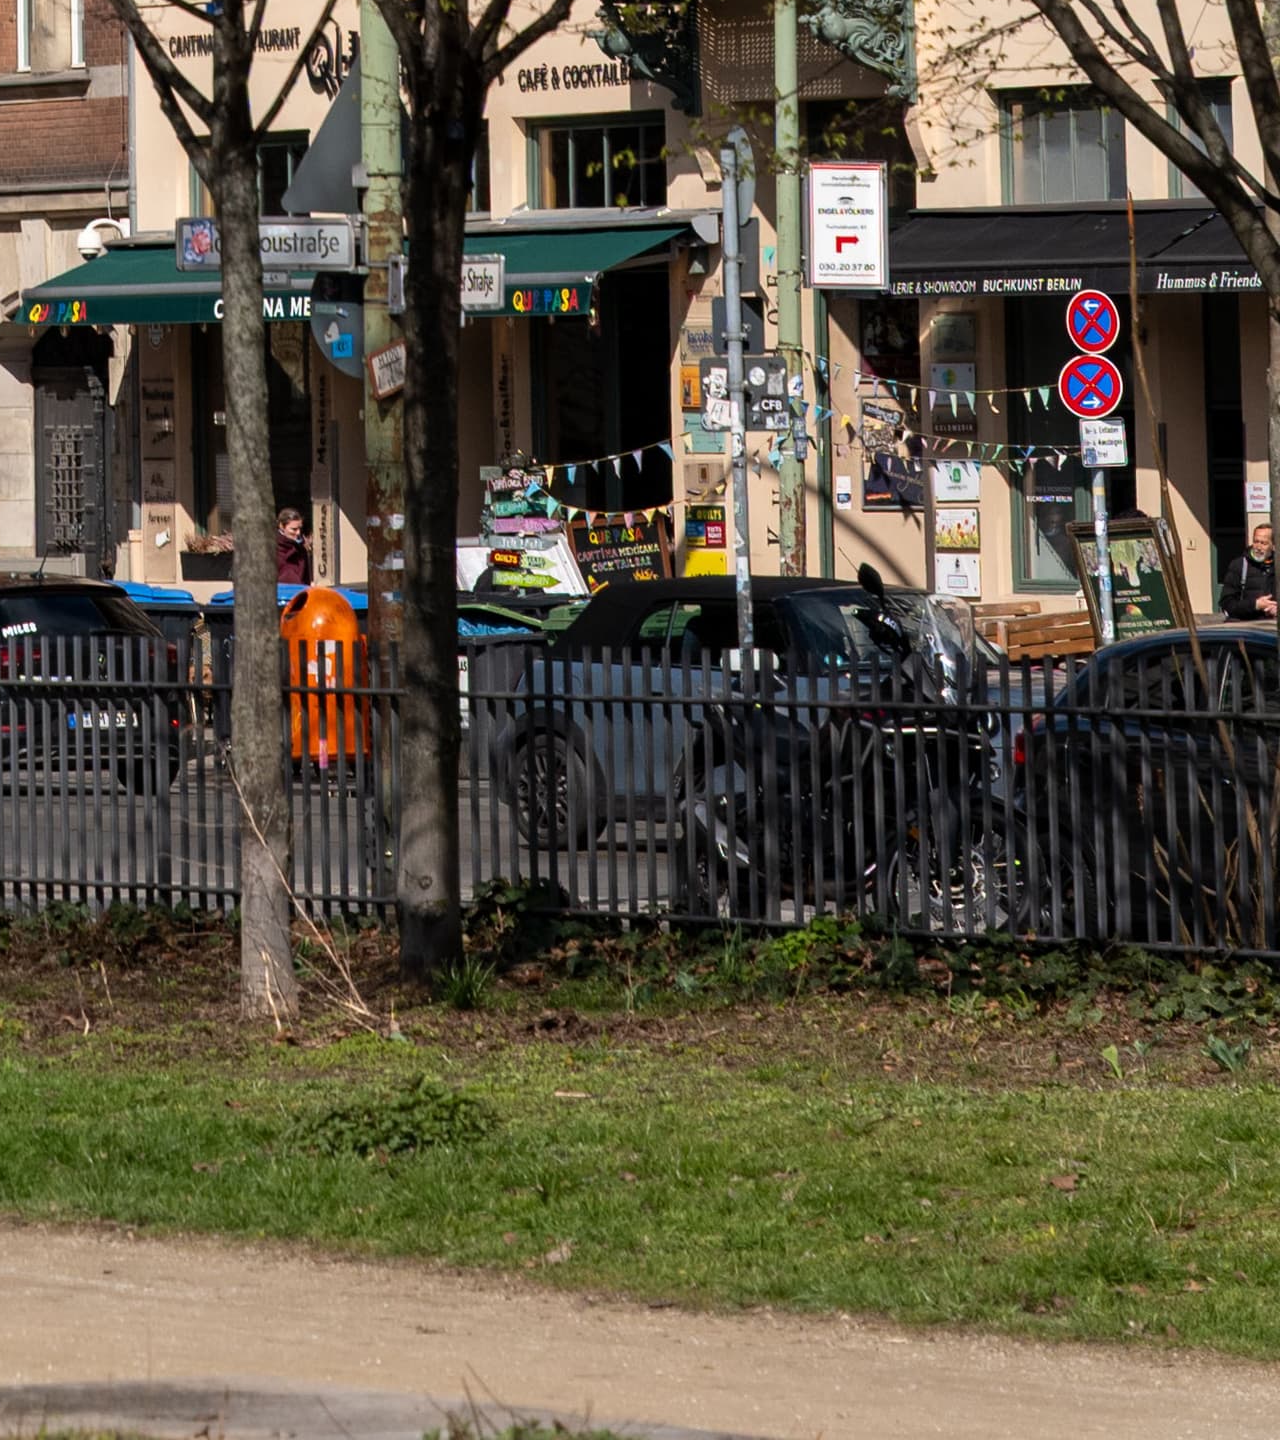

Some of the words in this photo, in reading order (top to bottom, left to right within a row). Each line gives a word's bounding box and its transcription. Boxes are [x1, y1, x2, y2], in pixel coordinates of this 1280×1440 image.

[467, 268, 494, 298] Straße
[923, 281, 976, 294] SHOWROOM
[982, 279, 1043, 293] BUCHKUNST
[1047, 278, 1082, 291] BERLIN
[1156, 273, 1207, 289] Hummus
[1209, 272, 1218, 289] &
[1220, 271, 1262, 288] Friends
[56, 300, 87, 322] PASA
[512, 290, 540, 313] QUE
[543, 288, 579, 312] PASA
[318, 503, 328, 578] Cantina
[494, 553, 518, 564] QUILTS
